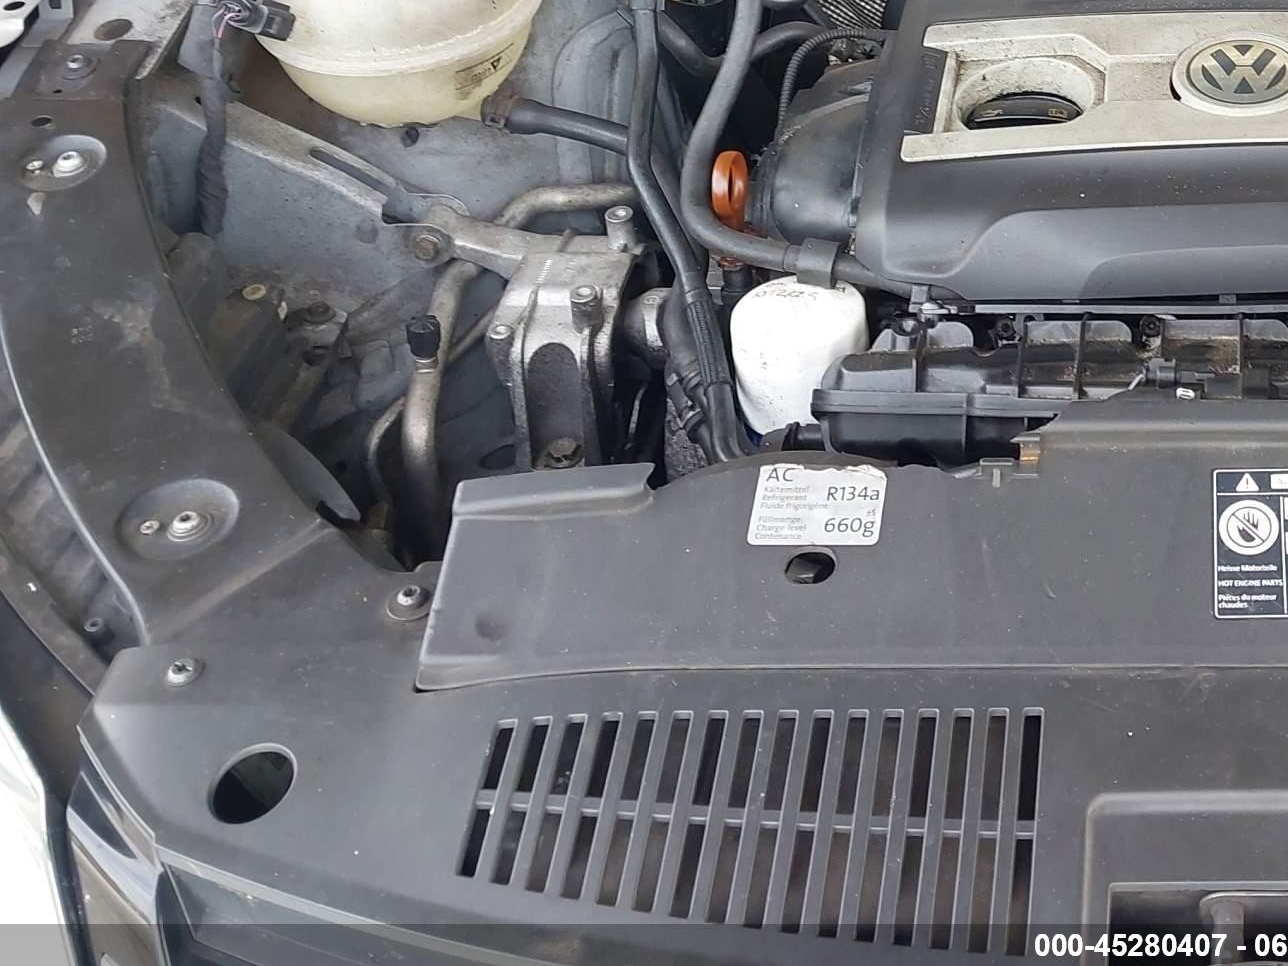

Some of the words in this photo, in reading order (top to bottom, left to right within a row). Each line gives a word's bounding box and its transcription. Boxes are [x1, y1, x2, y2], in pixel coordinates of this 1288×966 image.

[766, 467, 796, 482] AC
[826, 486, 880, 501] R134a
[824, 518, 875, 537] 660g
